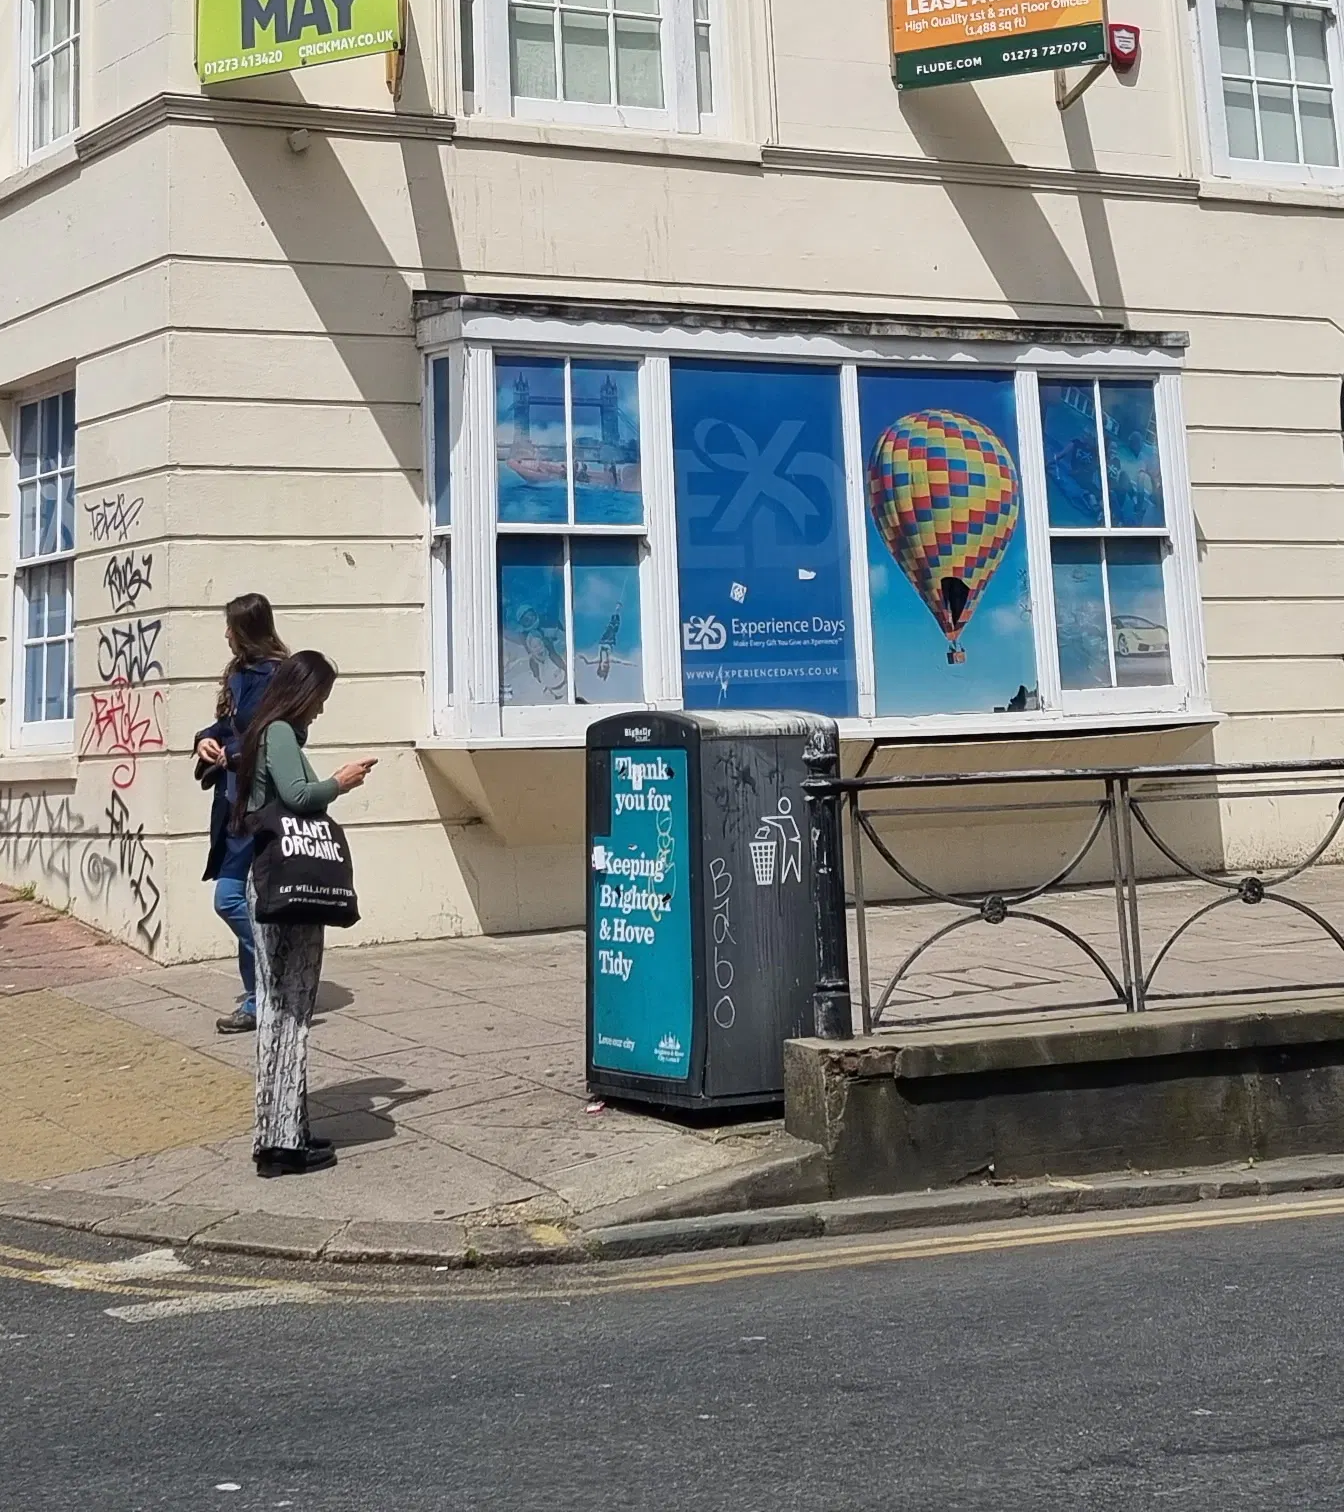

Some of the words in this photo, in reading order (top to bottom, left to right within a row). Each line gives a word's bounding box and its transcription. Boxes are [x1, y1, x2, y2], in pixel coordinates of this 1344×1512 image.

[905, 18, 929, 33] High
[930, 12, 968, 29] Quality
[969, 9, 986, 22] 1st
[987, 8, 996, 19] &
[998, 3, 1019, 18] 2nd
[1021, 0, 1049, 14] Floor
[998, 20, 1012, 32] sq
[298, 30, 393, 58] CRICKMAY.CO.UK
[1002, 48, 1038, 62] 01273
[1042, 41, 1087, 57] 727070
[204, 54, 238, 75] 01273
[241, 50, 283, 69] 413420
[916, 56, 983, 75] FLUDE.COM
[731, 617, 809, 638] Experience
[812, 616, 846, 636] Days
[615, 793, 645, 815] you
[647, 787, 672, 811] for
[281, 816, 332, 840] PLANET
[281, 835, 344, 862] ORGANIC
[601, 851, 664, 882] Keeping
[600, 884, 671, 914] Brighton
[599, 917, 610, 940] &
[612, 918, 655, 944] Hove
[599, 949, 633, 981] Tidy
[623, 1037, 636, 1052] city
